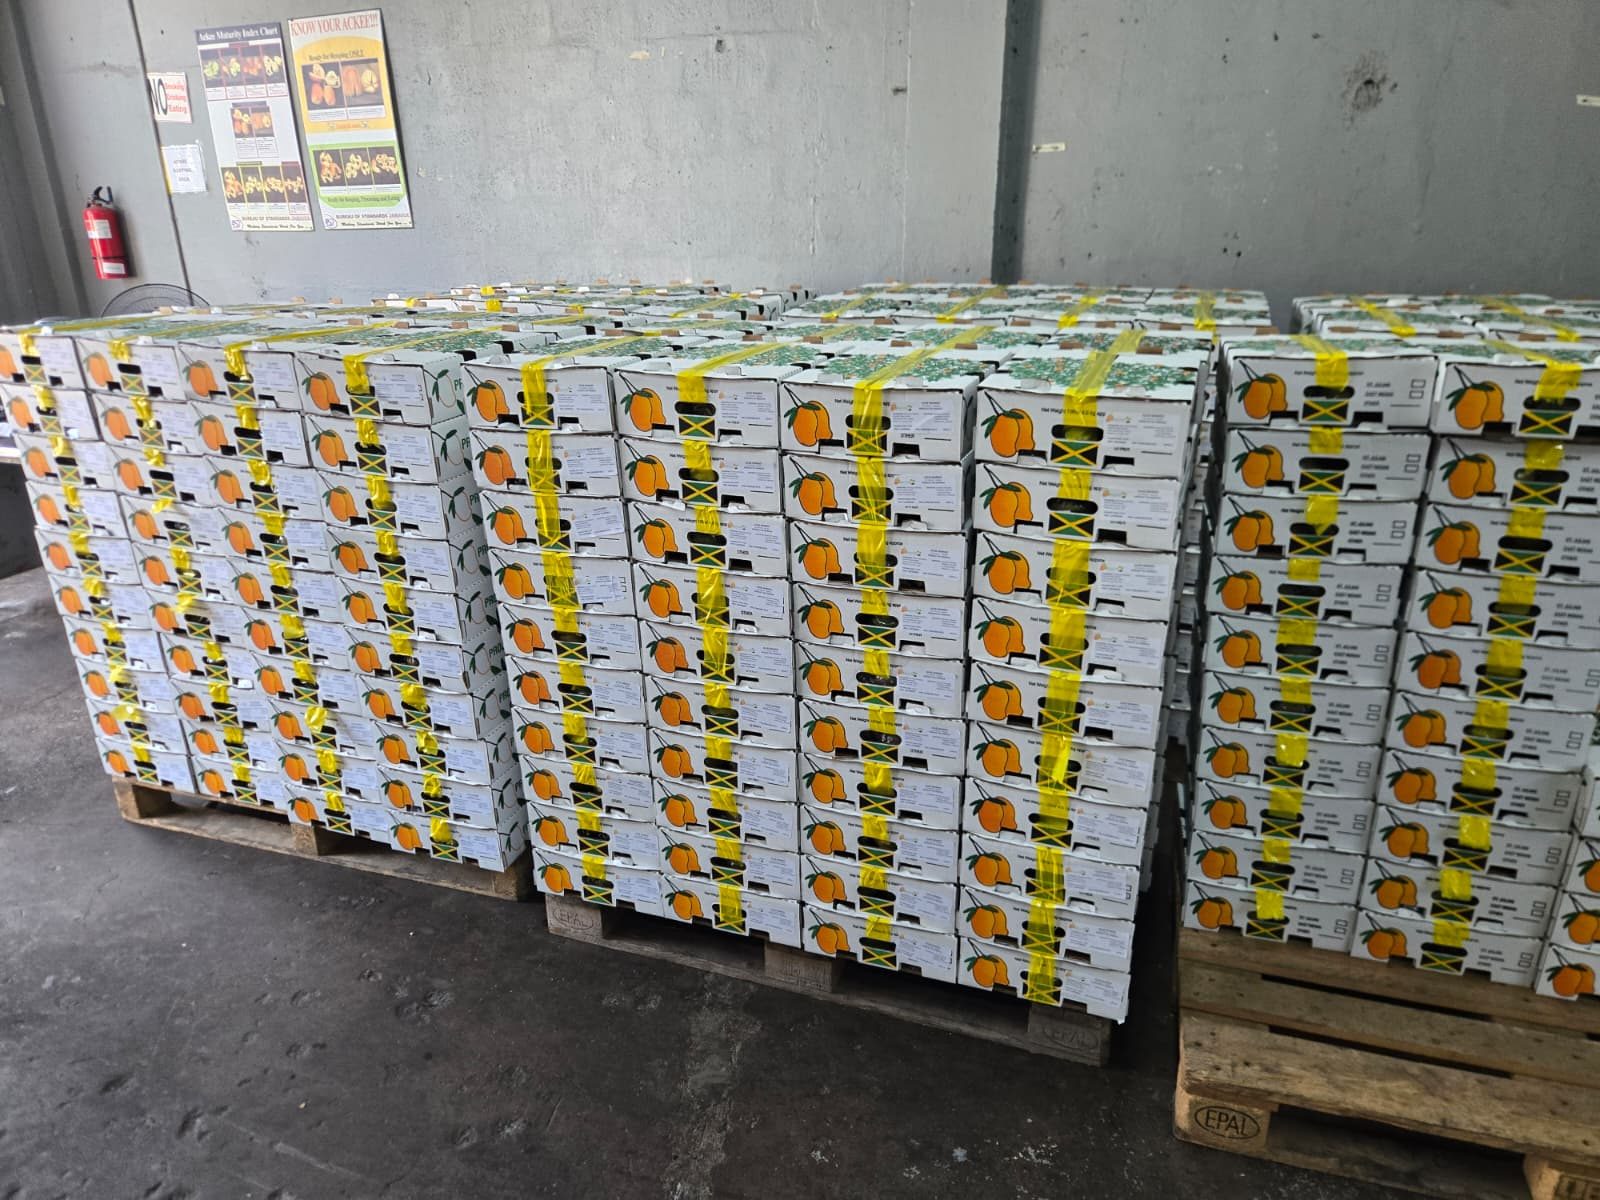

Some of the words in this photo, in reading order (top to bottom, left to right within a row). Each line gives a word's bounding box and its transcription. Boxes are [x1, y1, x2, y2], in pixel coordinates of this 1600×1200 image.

[260, 26, 279, 36] Chart
[291, 21, 316, 36] KNOW
[317, 17, 341, 33] YOUR
[149, 77, 167, 115] NO
[1205, 1109, 1249, 1137] EPAL
